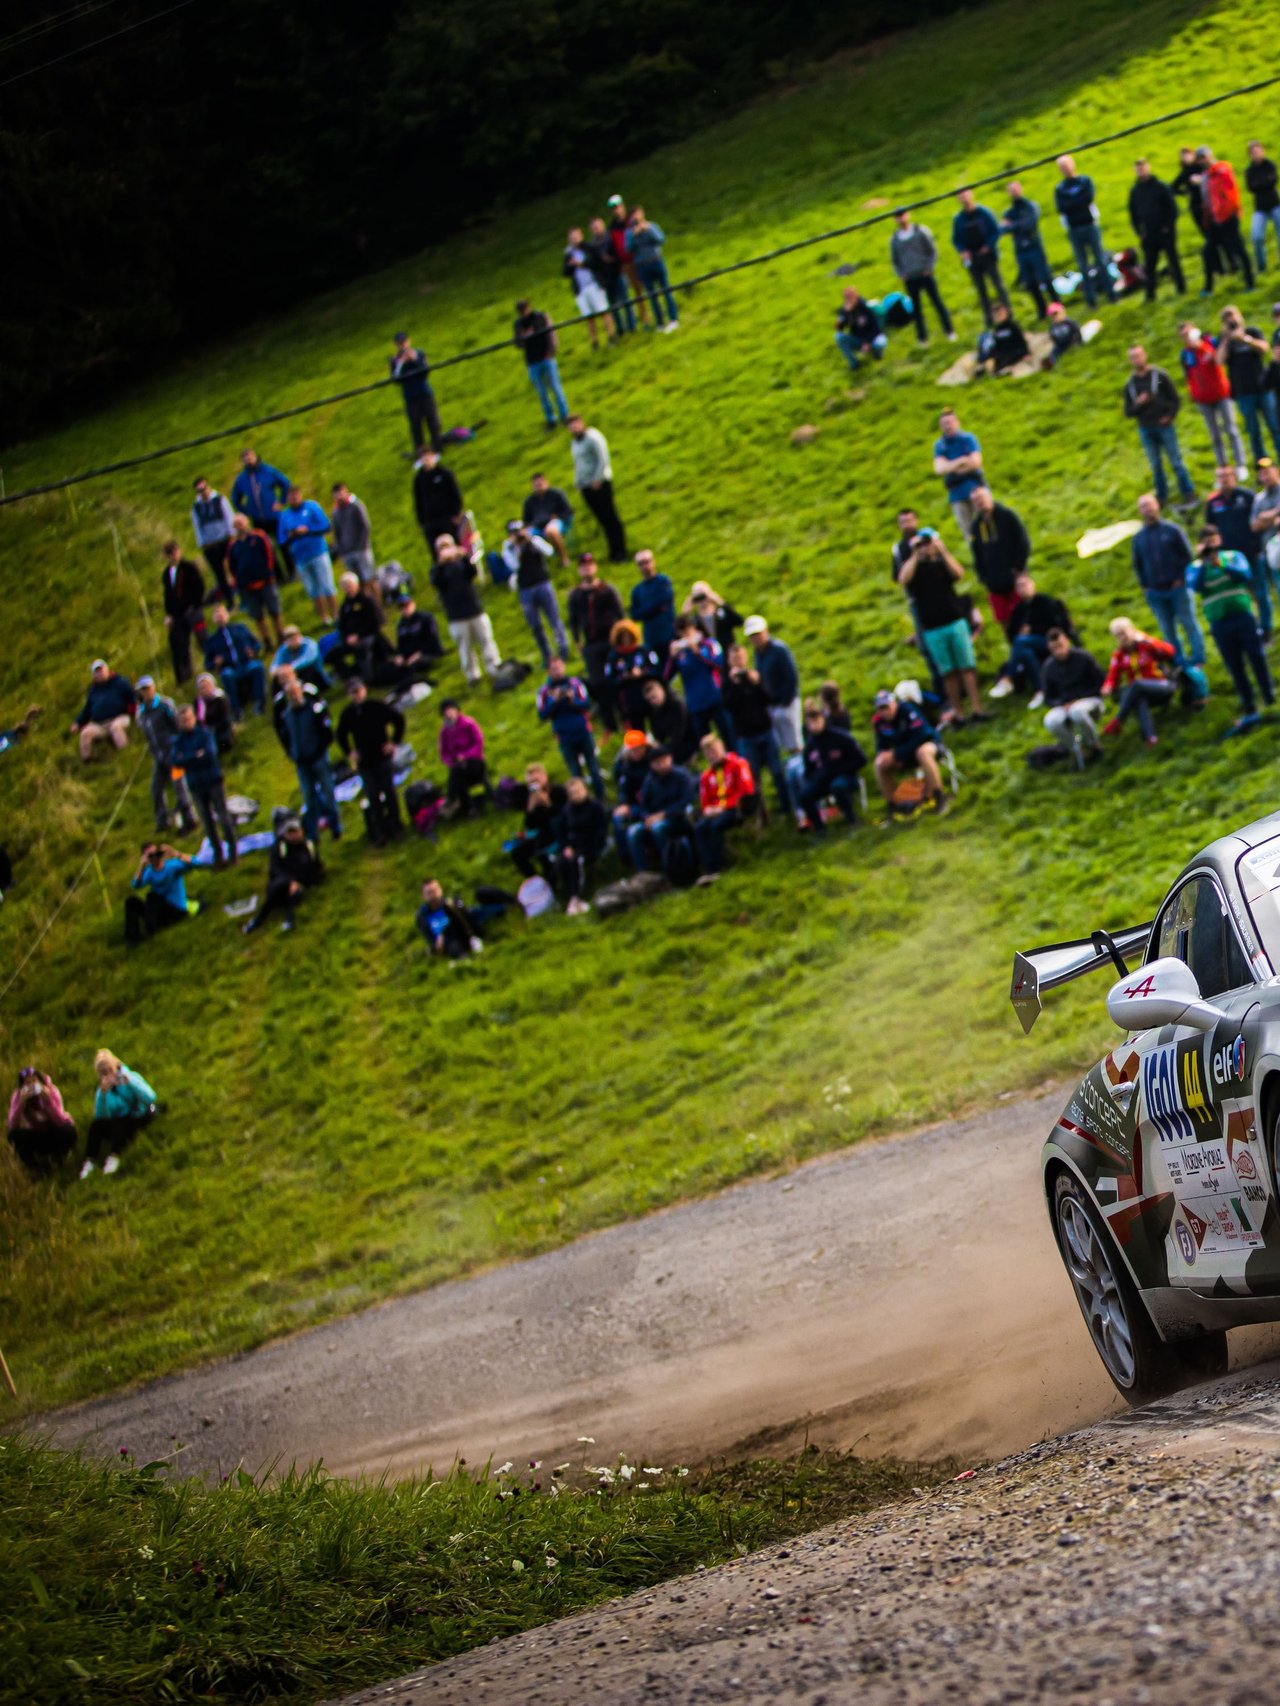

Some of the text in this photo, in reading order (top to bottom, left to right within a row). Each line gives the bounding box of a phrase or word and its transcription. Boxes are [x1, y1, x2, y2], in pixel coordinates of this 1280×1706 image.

[1144, 1048, 1193, 1142] IGOL
[1183, 1049, 1213, 1124] 44
[1213, 1043, 1233, 1085] elf
